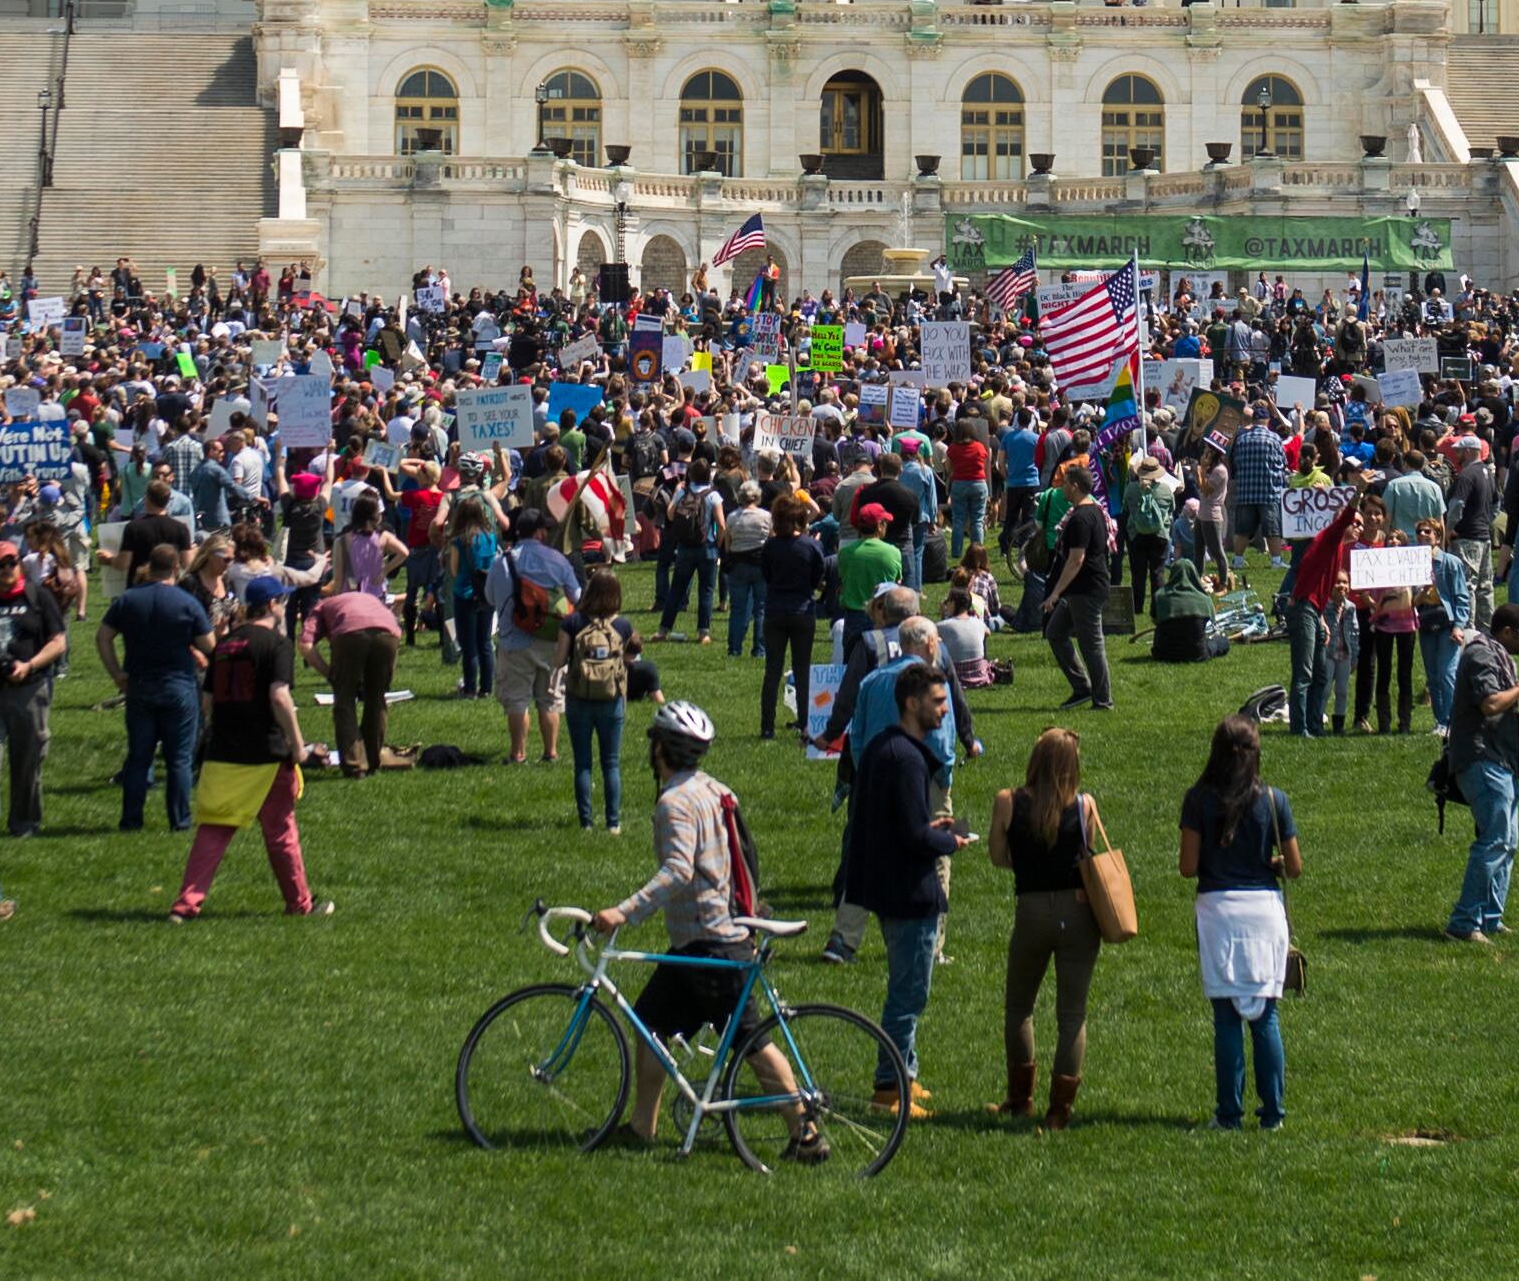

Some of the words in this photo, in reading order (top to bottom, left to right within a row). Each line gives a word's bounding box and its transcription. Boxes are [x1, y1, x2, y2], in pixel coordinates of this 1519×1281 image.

[951, 242, 986, 257] TAX
[1015, 235, 1150, 255] #TAXMARCH
[1182, 244, 1215, 260] TAX
[1244, 237, 1381, 258] @TAXMARCH
[1411, 245, 1442, 260] TAX
[1041, 301, 1071, 310] NIGHT
[755, 314, 780, 325] STOP
[923, 327, 938, 339] DO
[944, 326, 967, 341] YOU
[947, 344, 969, 361] WITH
[1386, 342, 1416, 353] What
[923, 364, 941, 379] THE
[476, 392, 508, 405] PATRIOT
[500, 408, 520, 419] YOUR
[32, 425, 65, 442] Not
[470, 421, 515, 439] TAXES!
[760, 415, 814, 437] CHICKEN
[761, 435, 774, 447] IN
[779, 437, 808, 451] CHIEF
[49, 443, 71, 464] Up
[23, 462, 68, 482] Trump
[1282, 486, 1357, 515] GROSS
[1354, 550, 1381, 567] TAX
[1388, 549, 1430, 564] EVADER
